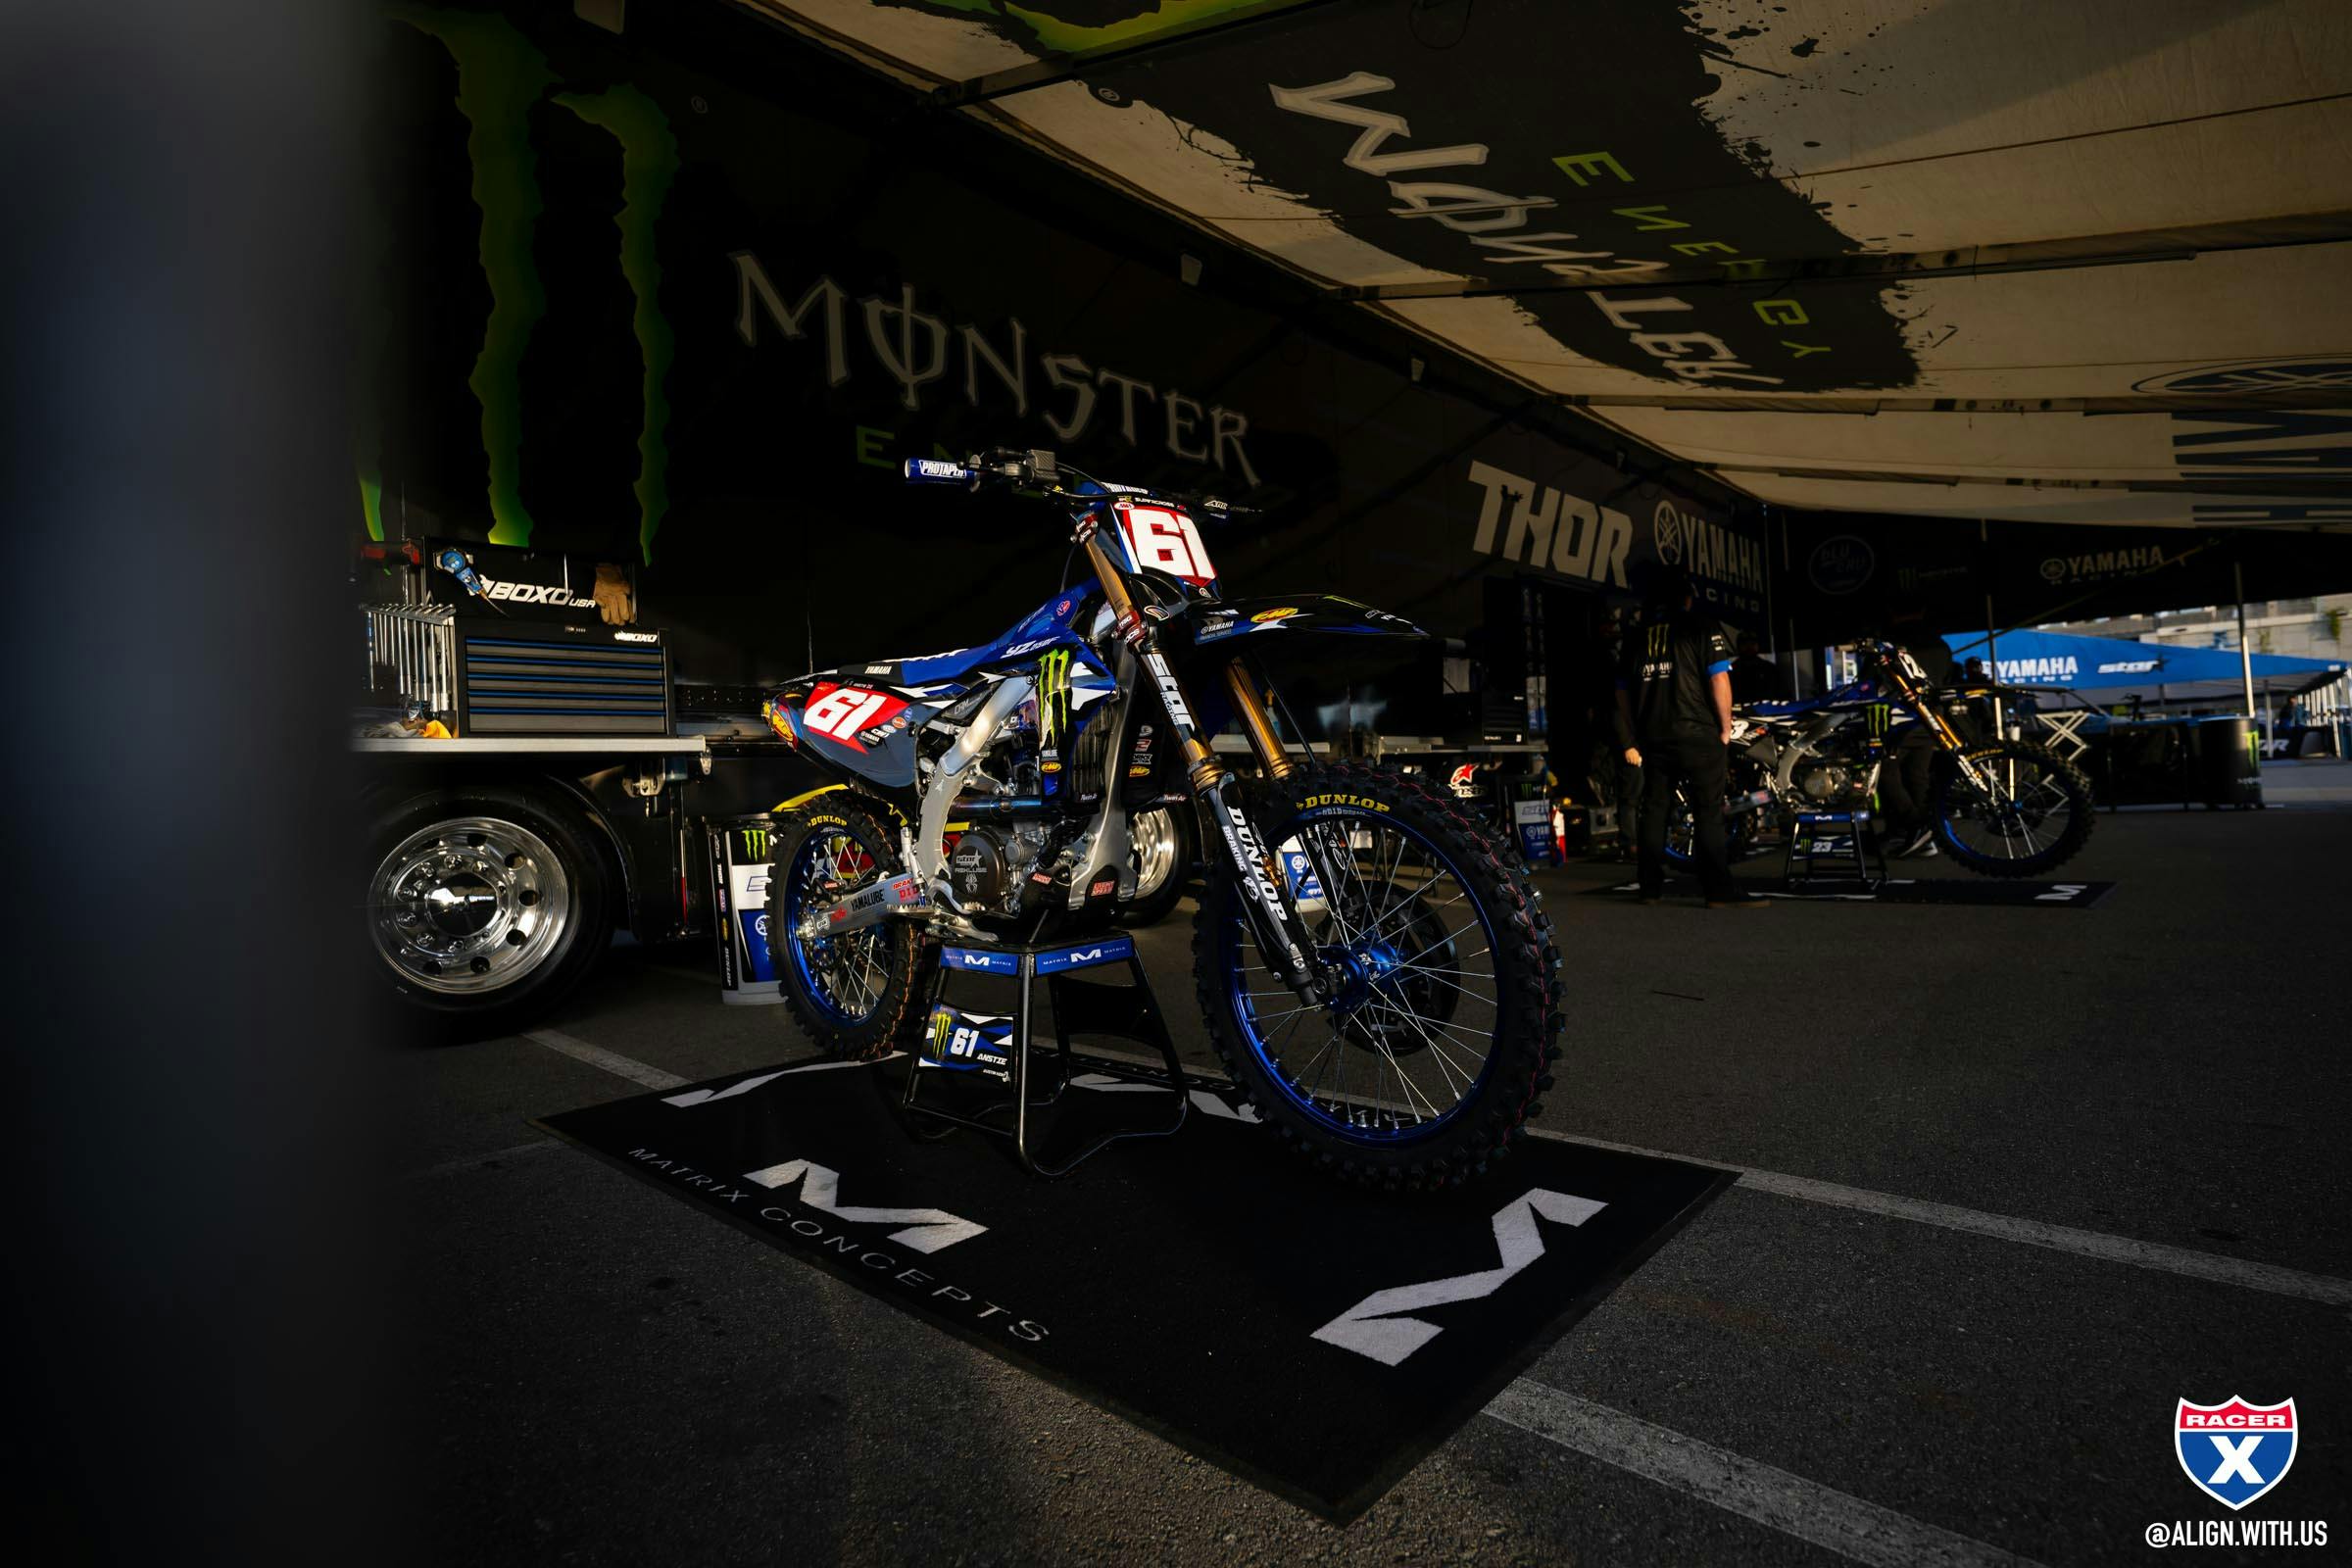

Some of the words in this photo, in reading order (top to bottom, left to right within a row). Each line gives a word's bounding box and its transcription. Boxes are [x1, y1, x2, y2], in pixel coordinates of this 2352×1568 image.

[726, 249, 1261, 488] MONSTER
[1467, 459, 1633, 592] THOR
[1129, 508, 1216, 580] 61
[1681, 512, 1764, 594] YAMAHA
[2067, 544, 2163, 576] YAMAHA
[488, 580, 573, 606] BOXO
[568, 598, 596, 609] USA
[1208, 621, 1235, 633] YAMAHA
[864, 665, 893, 675] YAMAHA
[1996, 657, 2078, 678] YAMAHA
[803, 688, 887, 741] 61
[1305, 795, 1391, 812] DUNLOP
[810, 815, 848, 827] DUNLOP
[1223, 826, 1248, 872] BRAKING
[1227, 807, 1288, 921] DUNLOP
[851, 890, 885, 911] YAMALUBE
[950, 1027, 980, 1057] 61
[976, 1053, 1008, 1065] ANSTIE
[627, 1147, 751, 1203] MATRIX
[760, 1206, 1050, 1343] CONCEPTS
